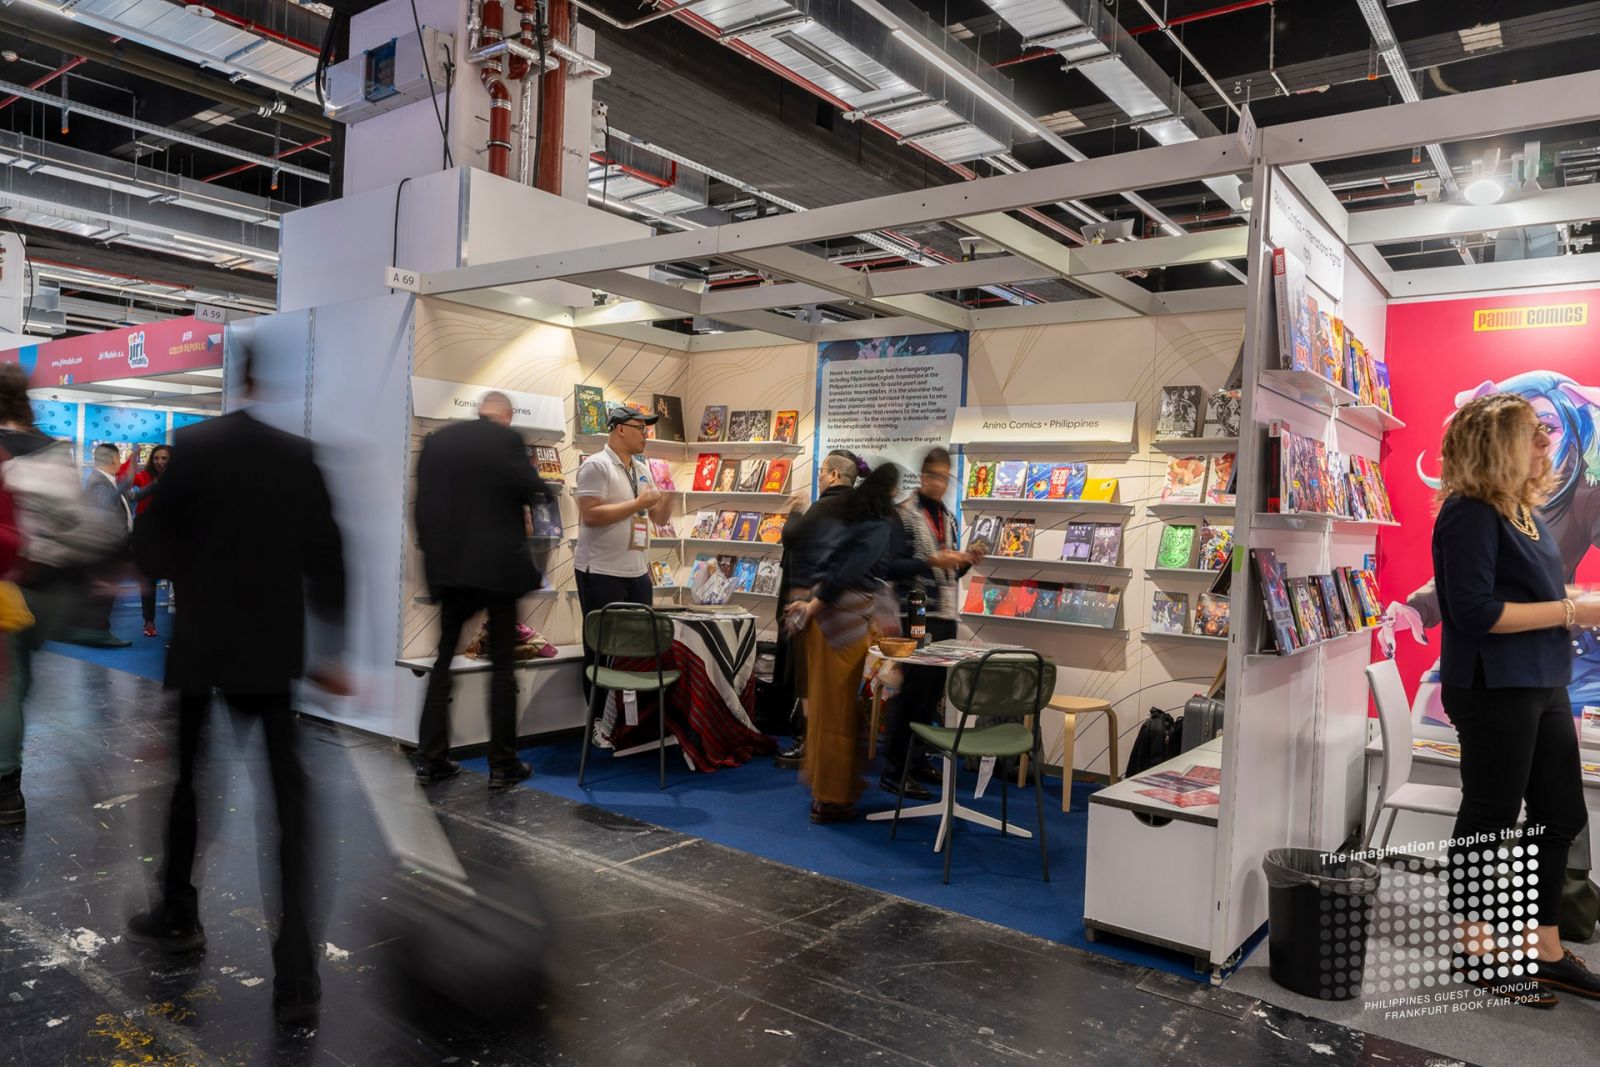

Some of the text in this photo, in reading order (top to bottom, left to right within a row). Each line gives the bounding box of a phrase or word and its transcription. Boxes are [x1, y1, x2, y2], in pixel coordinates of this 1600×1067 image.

[393, 274, 414, 286] A 69
[202, 308, 221, 319] A 59
[132, 358, 148, 366] models
[982, 419, 1099, 429] Anino Comics Philippines
